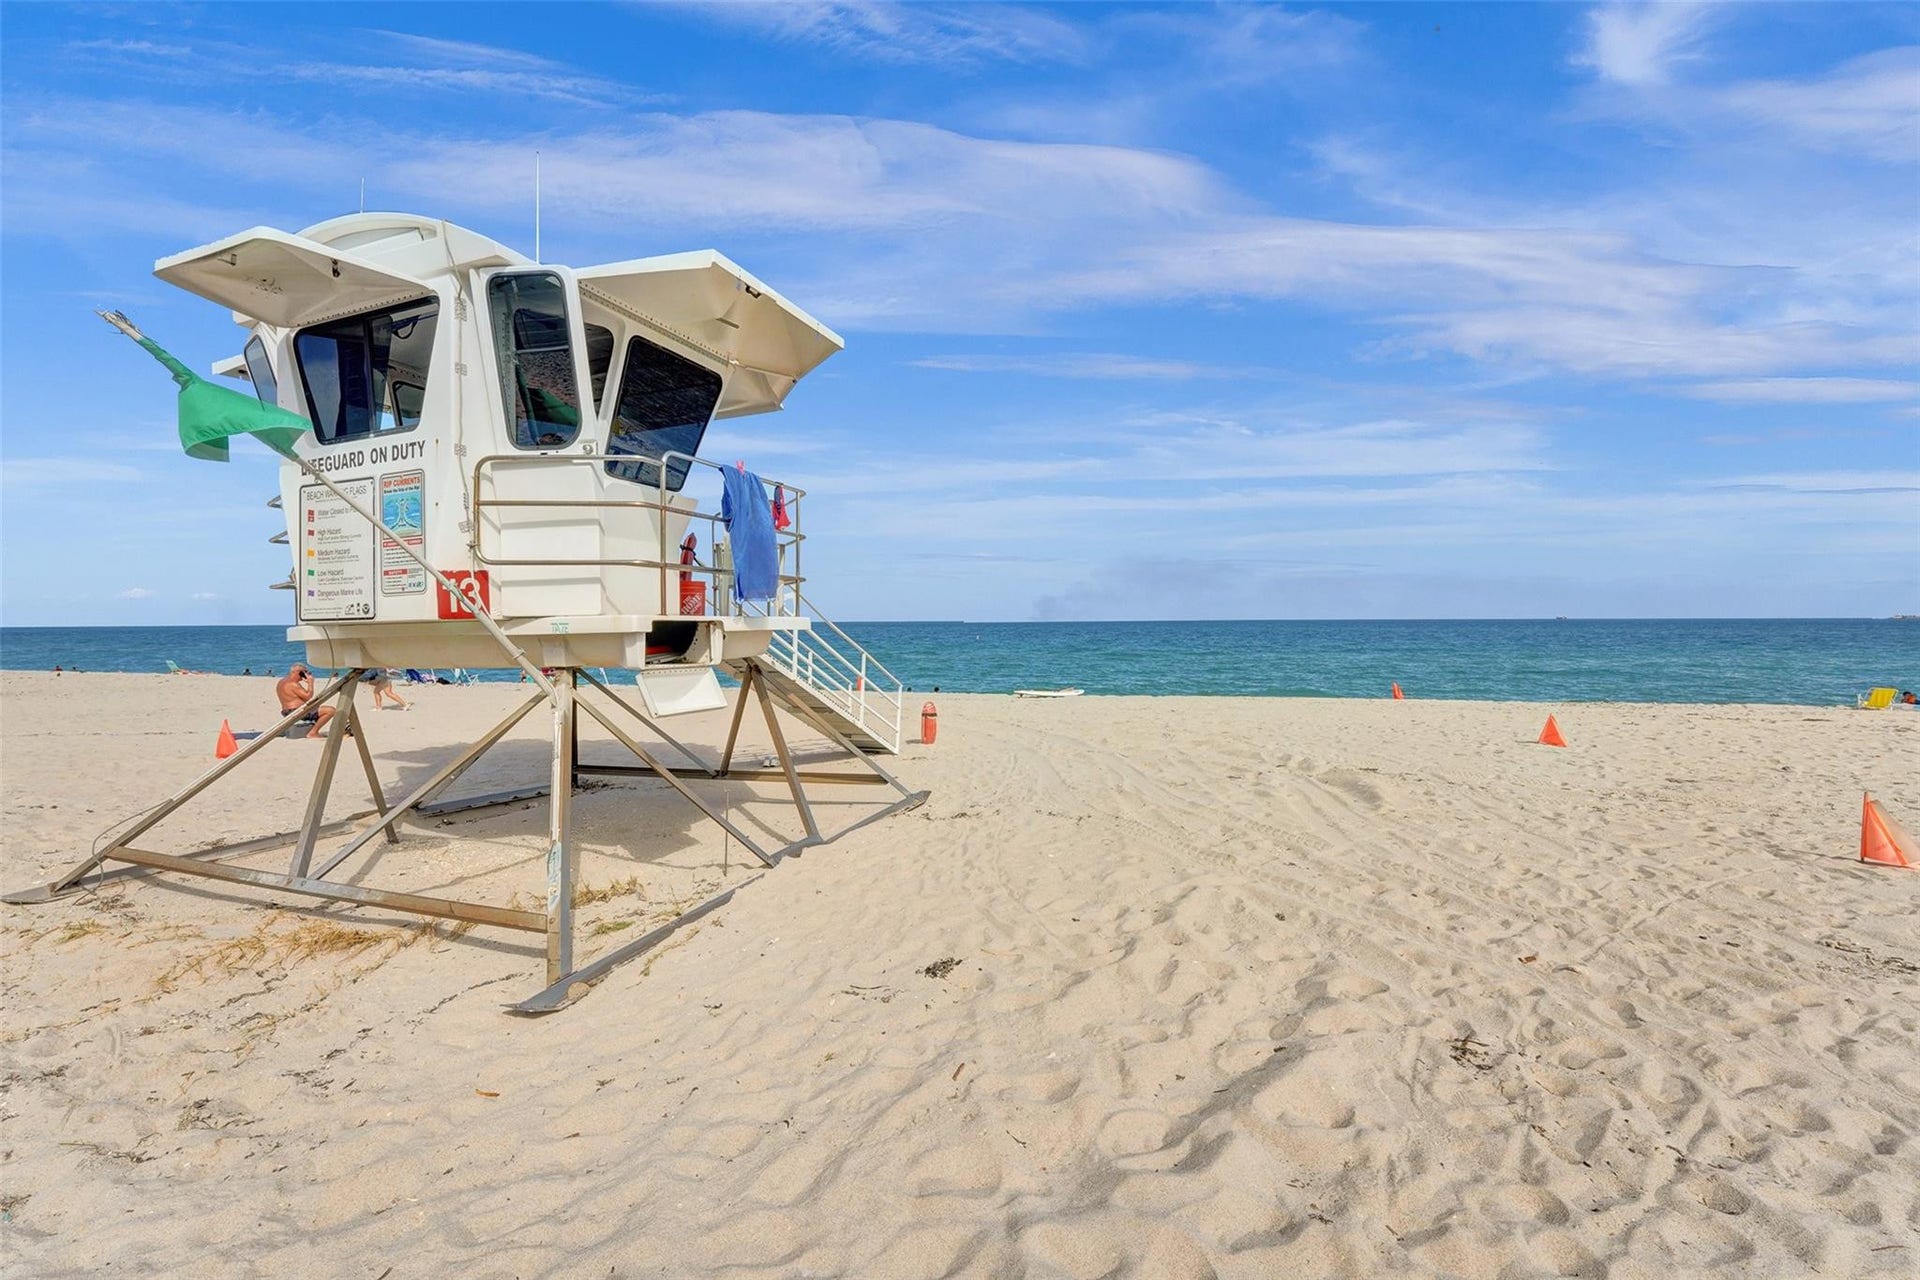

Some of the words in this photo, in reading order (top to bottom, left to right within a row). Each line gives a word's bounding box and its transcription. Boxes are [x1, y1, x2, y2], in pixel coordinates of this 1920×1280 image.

[370, 446, 387, 464] ON
[392, 440, 426, 461] DUTY
[384, 480, 392, 488] RIP
[393, 476, 420, 487] CURRENTS
[307, 489, 324, 501] BEACH
[349, 485, 367, 495] FLAGS
